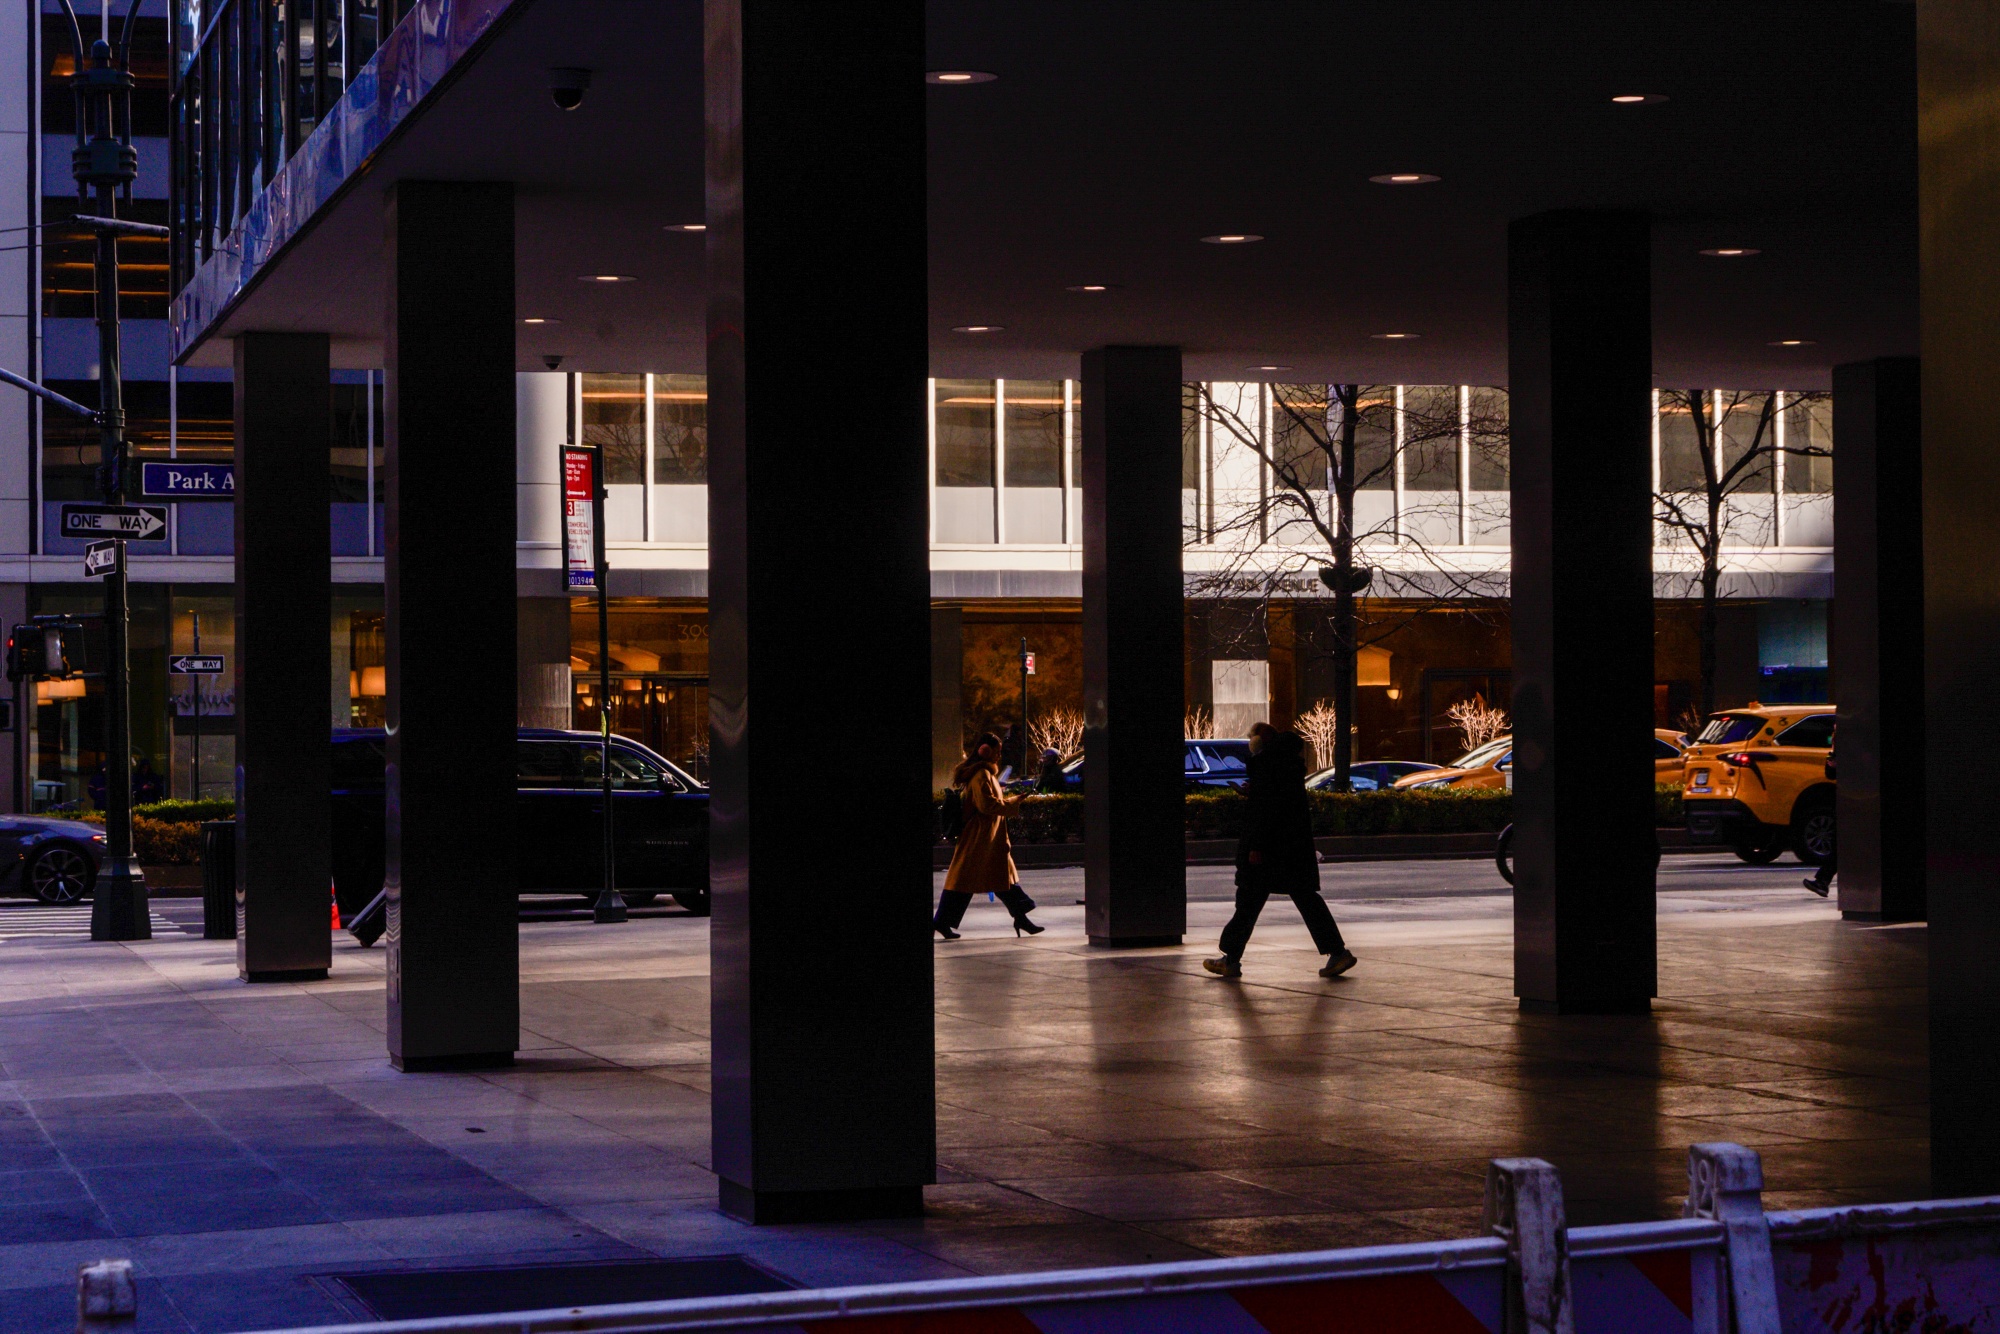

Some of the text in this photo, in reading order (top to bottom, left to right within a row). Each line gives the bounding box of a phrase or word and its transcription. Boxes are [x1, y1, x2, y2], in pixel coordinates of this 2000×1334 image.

[571, 453, 588, 461] STANDING
[167, 471, 216, 489] Park
[567, 501, 574, 516] 3
[70, 514, 152, 530] ONE WAY
[89, 549, 114, 567] ONE WAY
[1264, 578, 1319, 593] AVENUE
[180, 661, 195, 669] ONE
